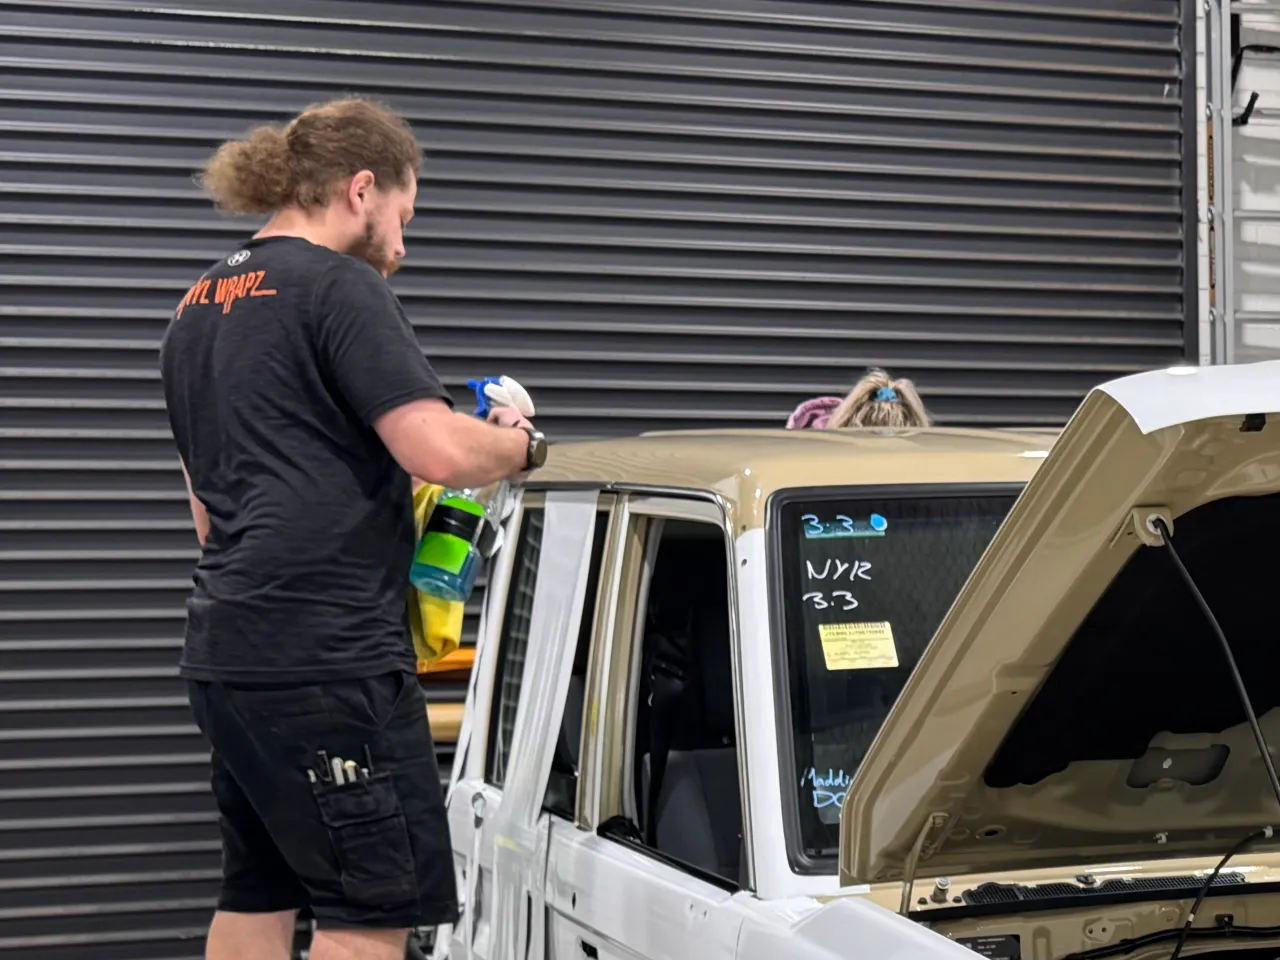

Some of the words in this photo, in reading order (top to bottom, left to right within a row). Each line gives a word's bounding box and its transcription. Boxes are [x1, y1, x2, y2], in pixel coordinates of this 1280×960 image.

[176, 273, 211, 320] NYL
[214, 270, 277, 315] WRAPZ
[801, 513, 854, 535] 3.3
[805, 558, 872, 581] NYR
[803, 591, 859, 610] 3.3
[800, 767, 853, 788] Maddi
